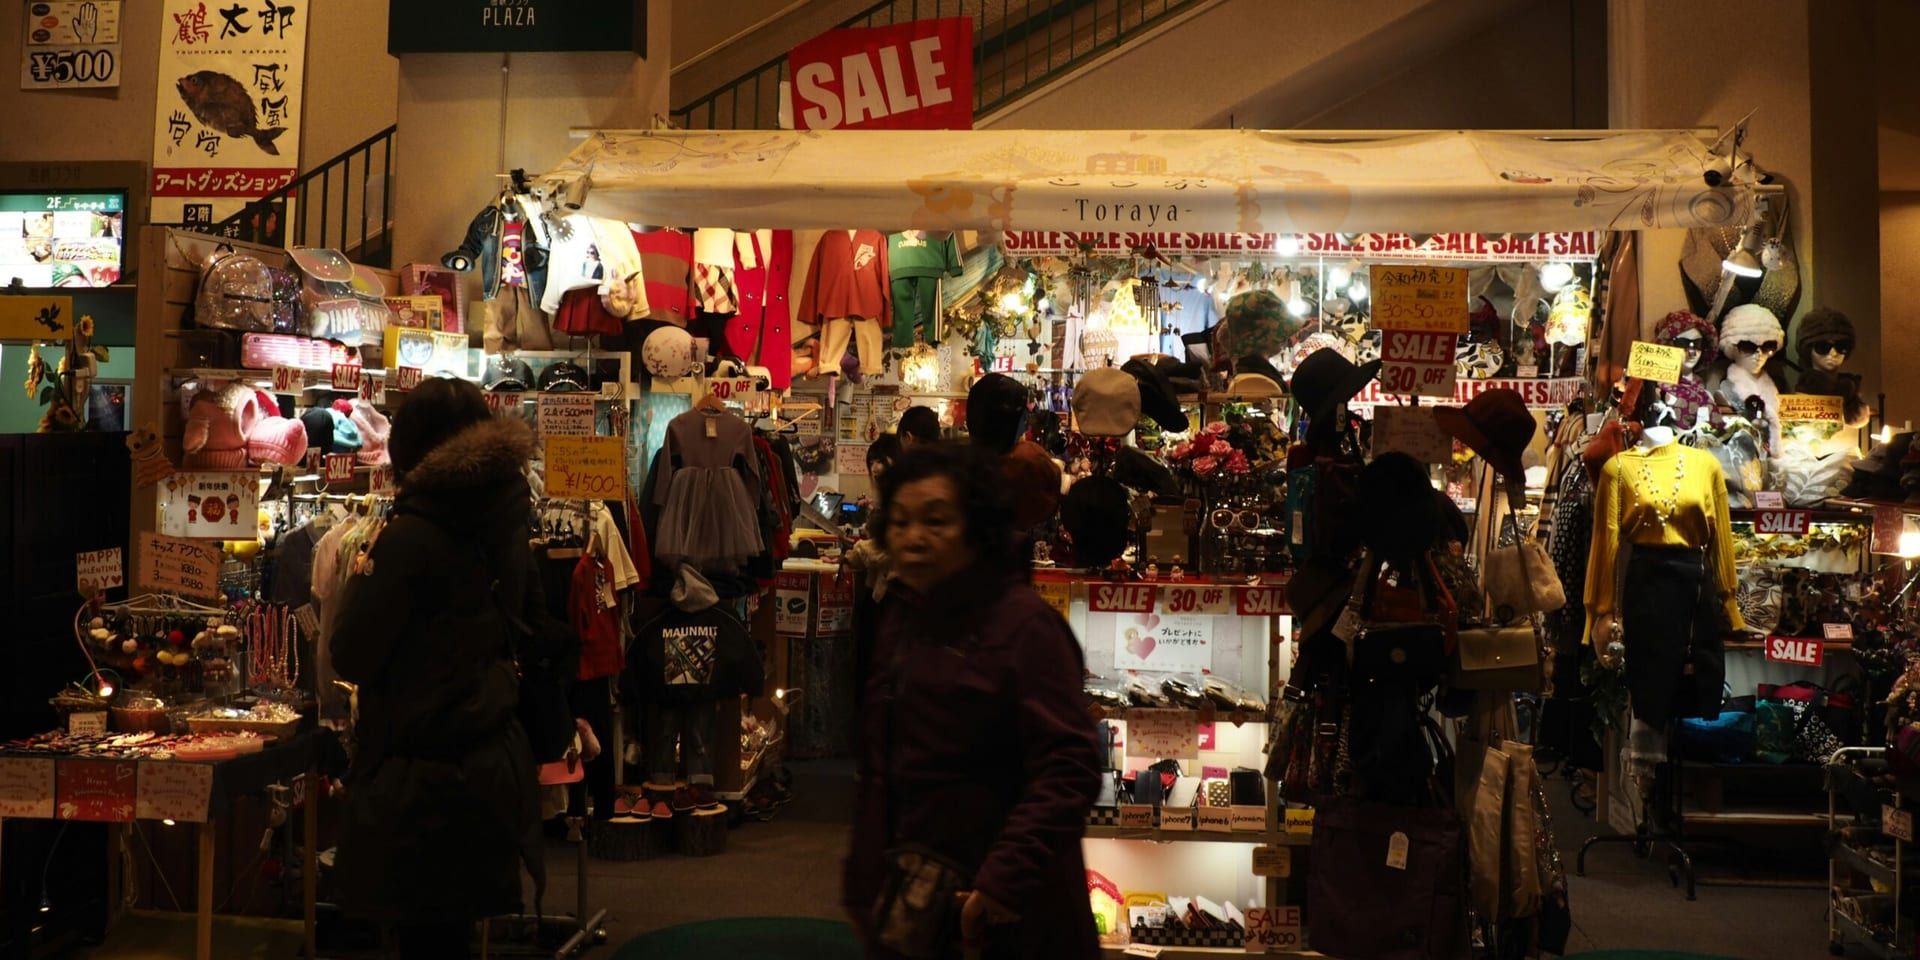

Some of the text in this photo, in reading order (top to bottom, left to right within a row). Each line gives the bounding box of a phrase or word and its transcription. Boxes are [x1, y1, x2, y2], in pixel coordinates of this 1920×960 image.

[172, 0, 295, 45] 鶴太郎
[483, 7, 535, 26] PLAZA
[31, 50, 114, 82] ¥500
[796, 36, 953, 130] SALE
[155, 169, 296, 192] アートグッズショップ
[47, 197, 62, 209] 2F
[186, 206, 211, 224] 2階
[1005, 231, 1061, 249] SALE
[1125, 231, 1181, 249] SALE
[1185, 231, 1242, 250] SALE
[1431, 232, 1488, 254] SALE
[1389, 332, 1449, 361] SALE
[334, 366, 359, 389] SALE
[735, 380, 751, 393] OFF
[1423, 368, 1447, 385] OFF
[504, 394, 519, 407] OFF
[328, 455, 354, 481] SALE
[1759, 511, 1806, 533] SALE
[78, 547, 121, 565] HAPPY
[1096, 586, 1151, 611] SALE
[1202, 589, 1224, 605] OFF
[1771, 639, 1818, 663] SALE
[1248, 909, 1299, 928] SALE
[1258, 929, 1296, 945] ¥500
